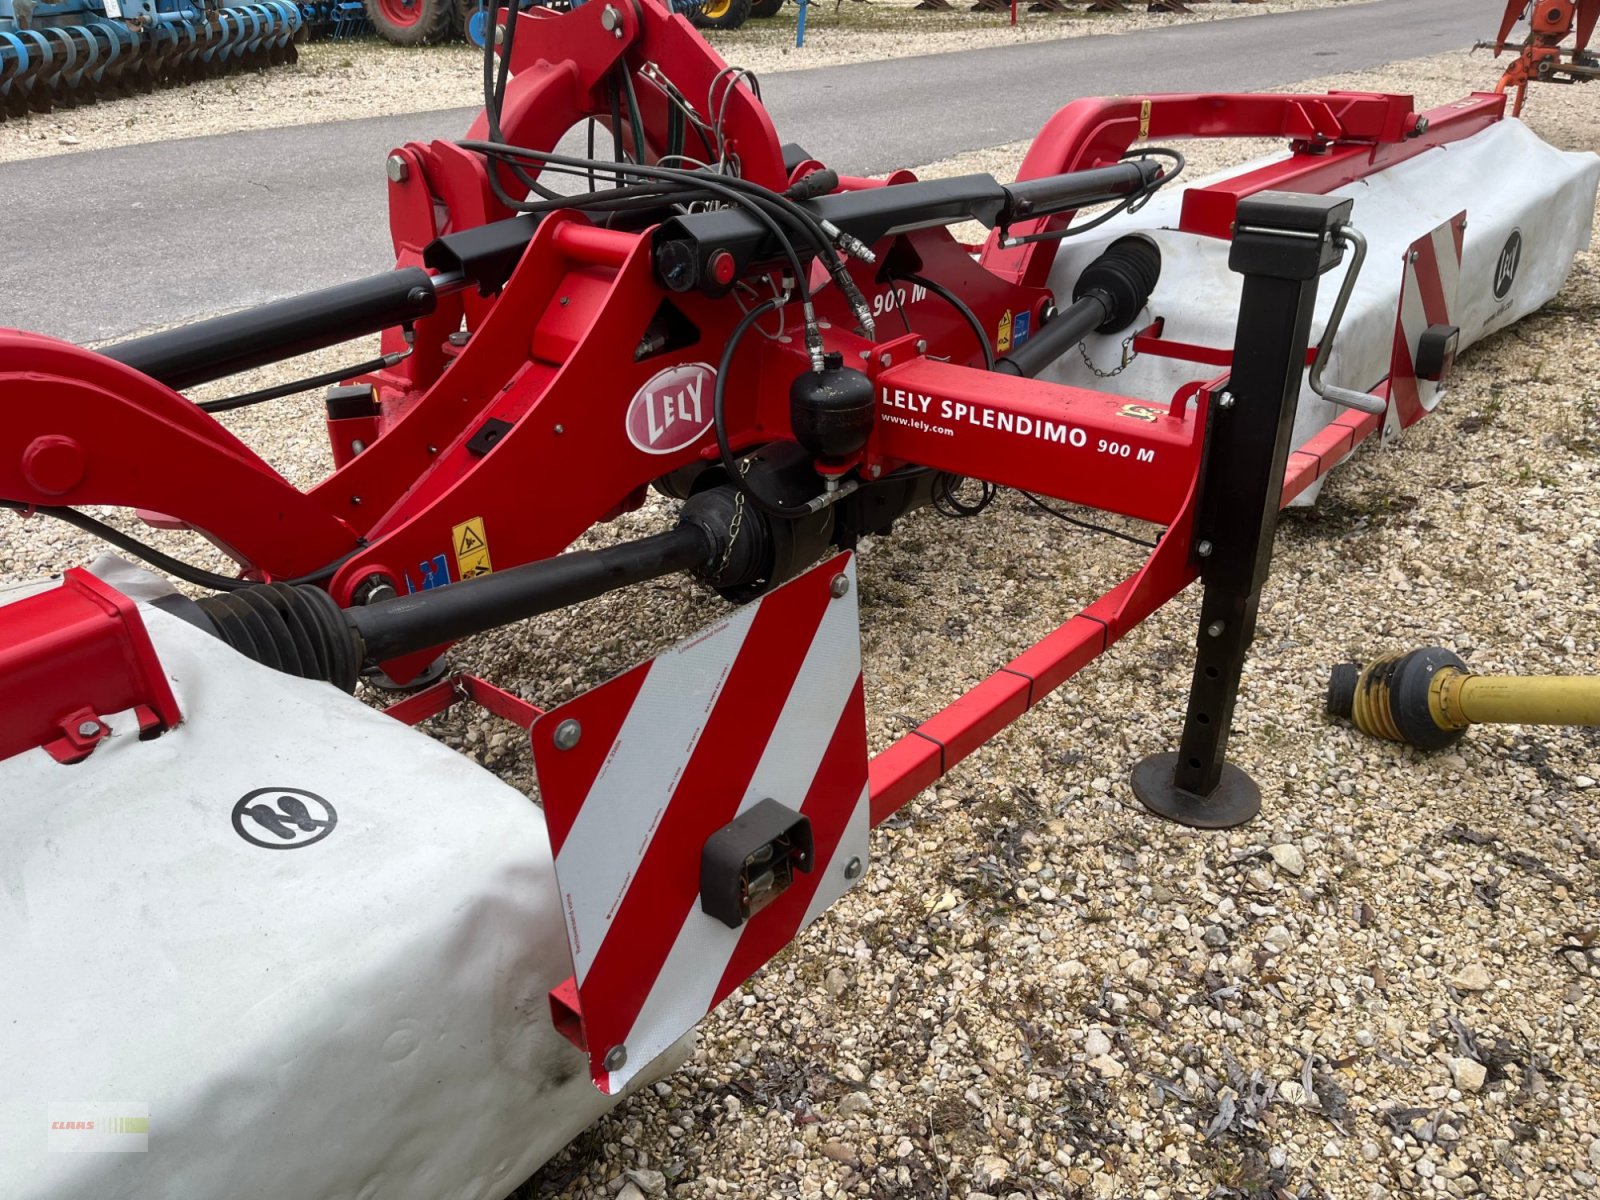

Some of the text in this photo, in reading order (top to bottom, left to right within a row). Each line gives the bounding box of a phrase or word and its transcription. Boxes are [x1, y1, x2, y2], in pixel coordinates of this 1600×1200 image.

[872, 283, 927, 317] 900 M
[645, 371, 703, 445] LELY
[881, 412, 955, 437] www.lely.com
[882, 387, 1156, 463] LELY SPLENDIMO 900 M
